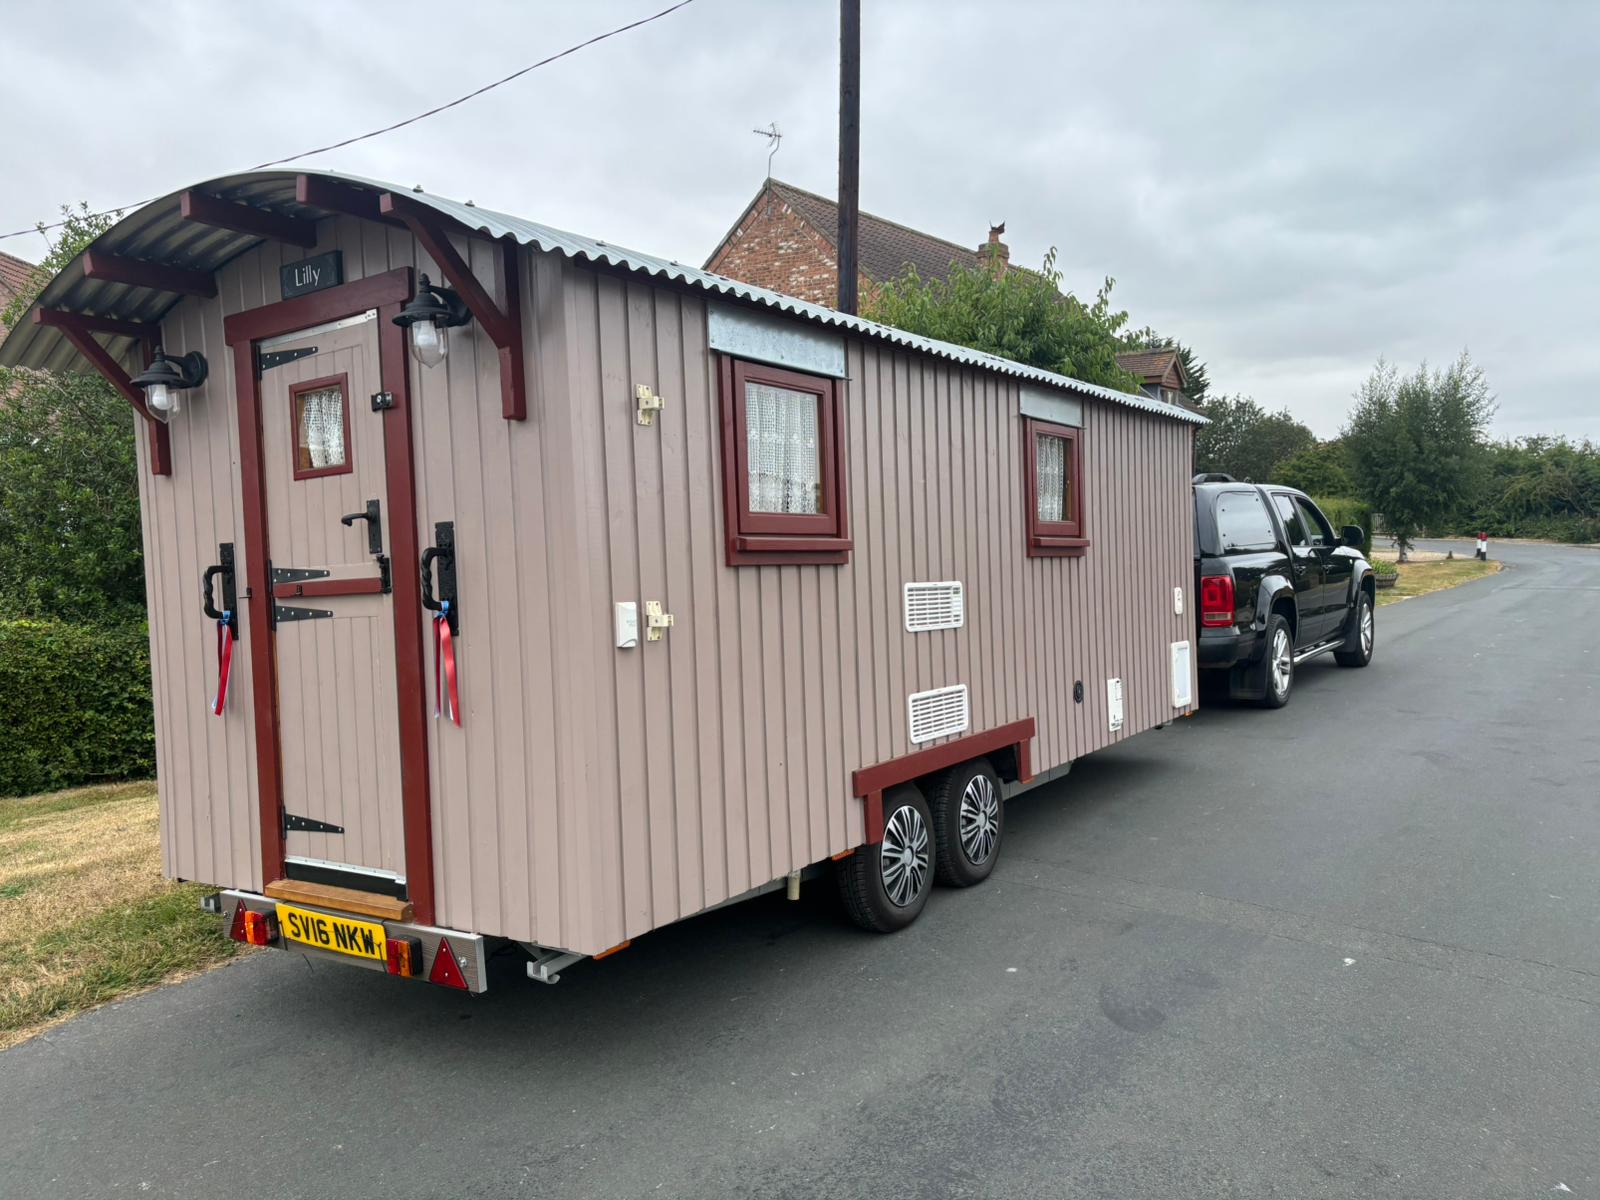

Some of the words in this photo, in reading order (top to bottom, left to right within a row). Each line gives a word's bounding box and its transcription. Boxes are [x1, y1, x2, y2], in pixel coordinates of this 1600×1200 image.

[295, 264, 321, 287] Lilly
[288, 912, 330, 945] SV16
[333, 922, 375, 955] NKW
